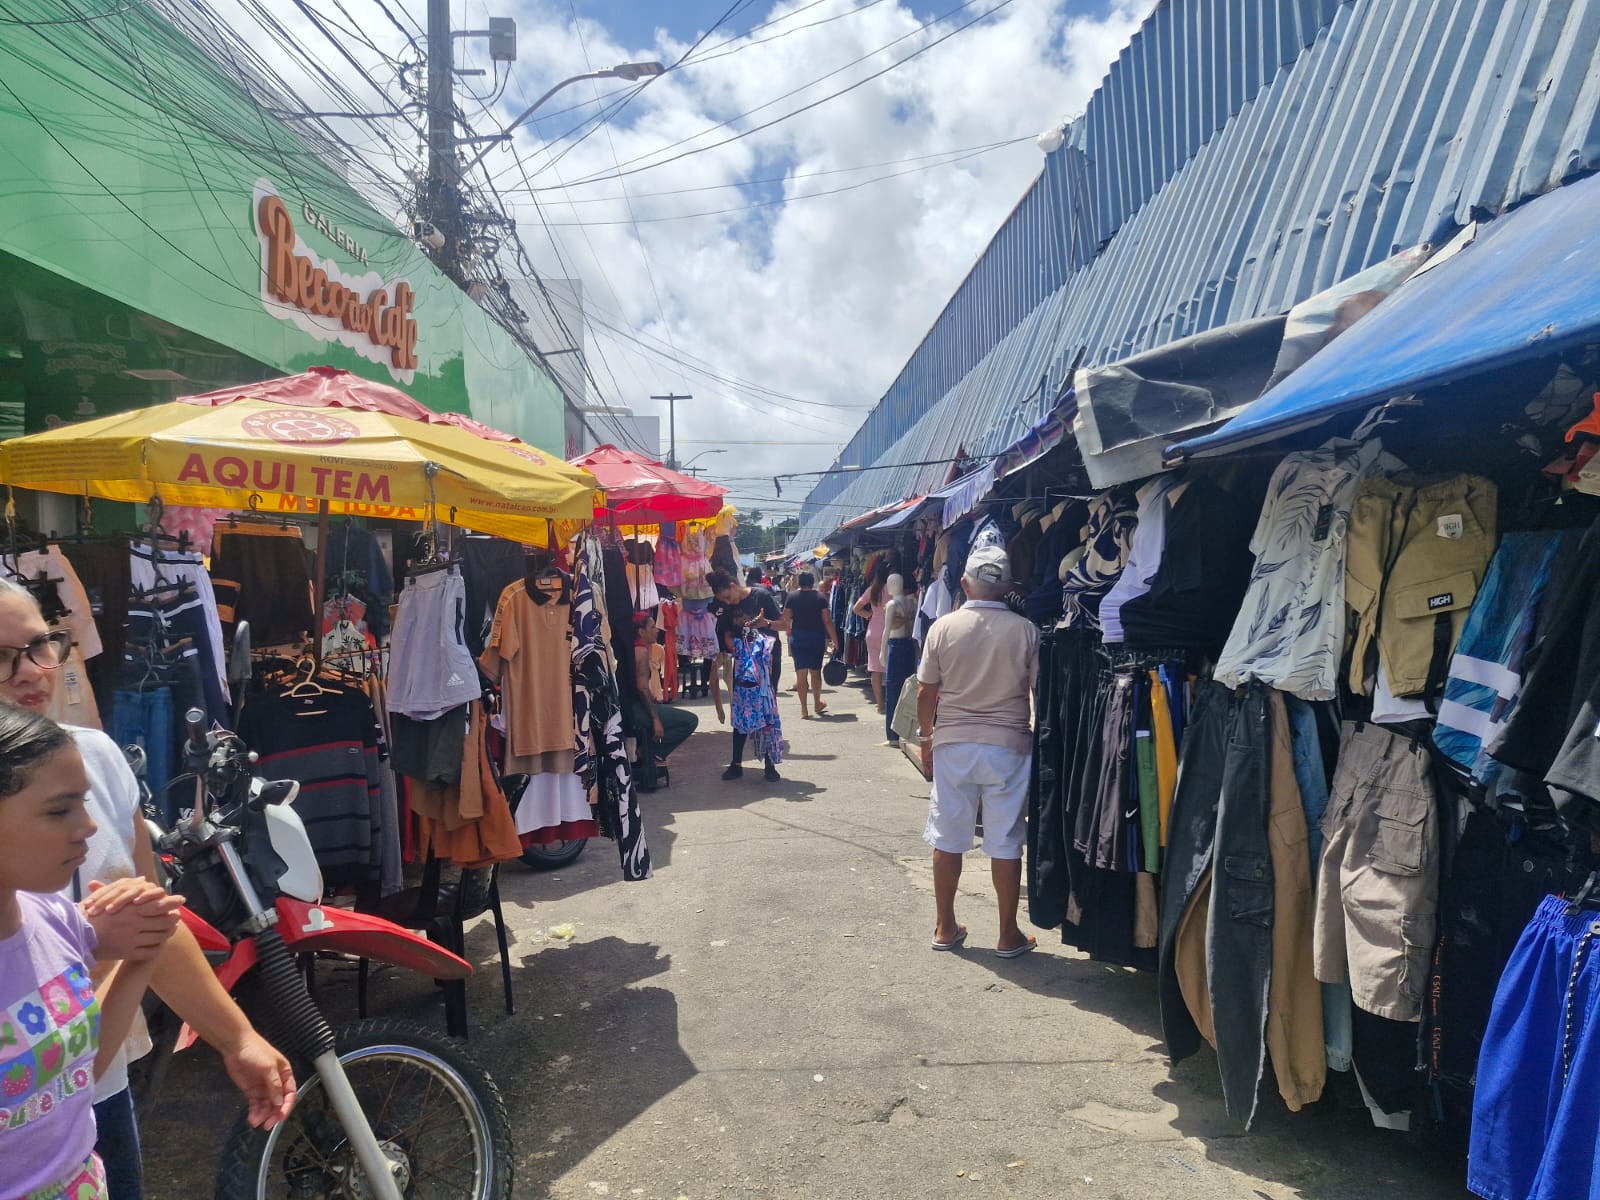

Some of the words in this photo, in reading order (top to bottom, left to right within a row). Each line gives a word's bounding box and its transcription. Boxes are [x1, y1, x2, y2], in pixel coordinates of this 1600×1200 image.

[258, 194, 349, 319] Beco
[303, 202, 369, 267] GALERIA
[177, 452, 296, 493] AQUI
[311, 466, 391, 503] TEM
[1430, 595, 1452, 608] HIGH
